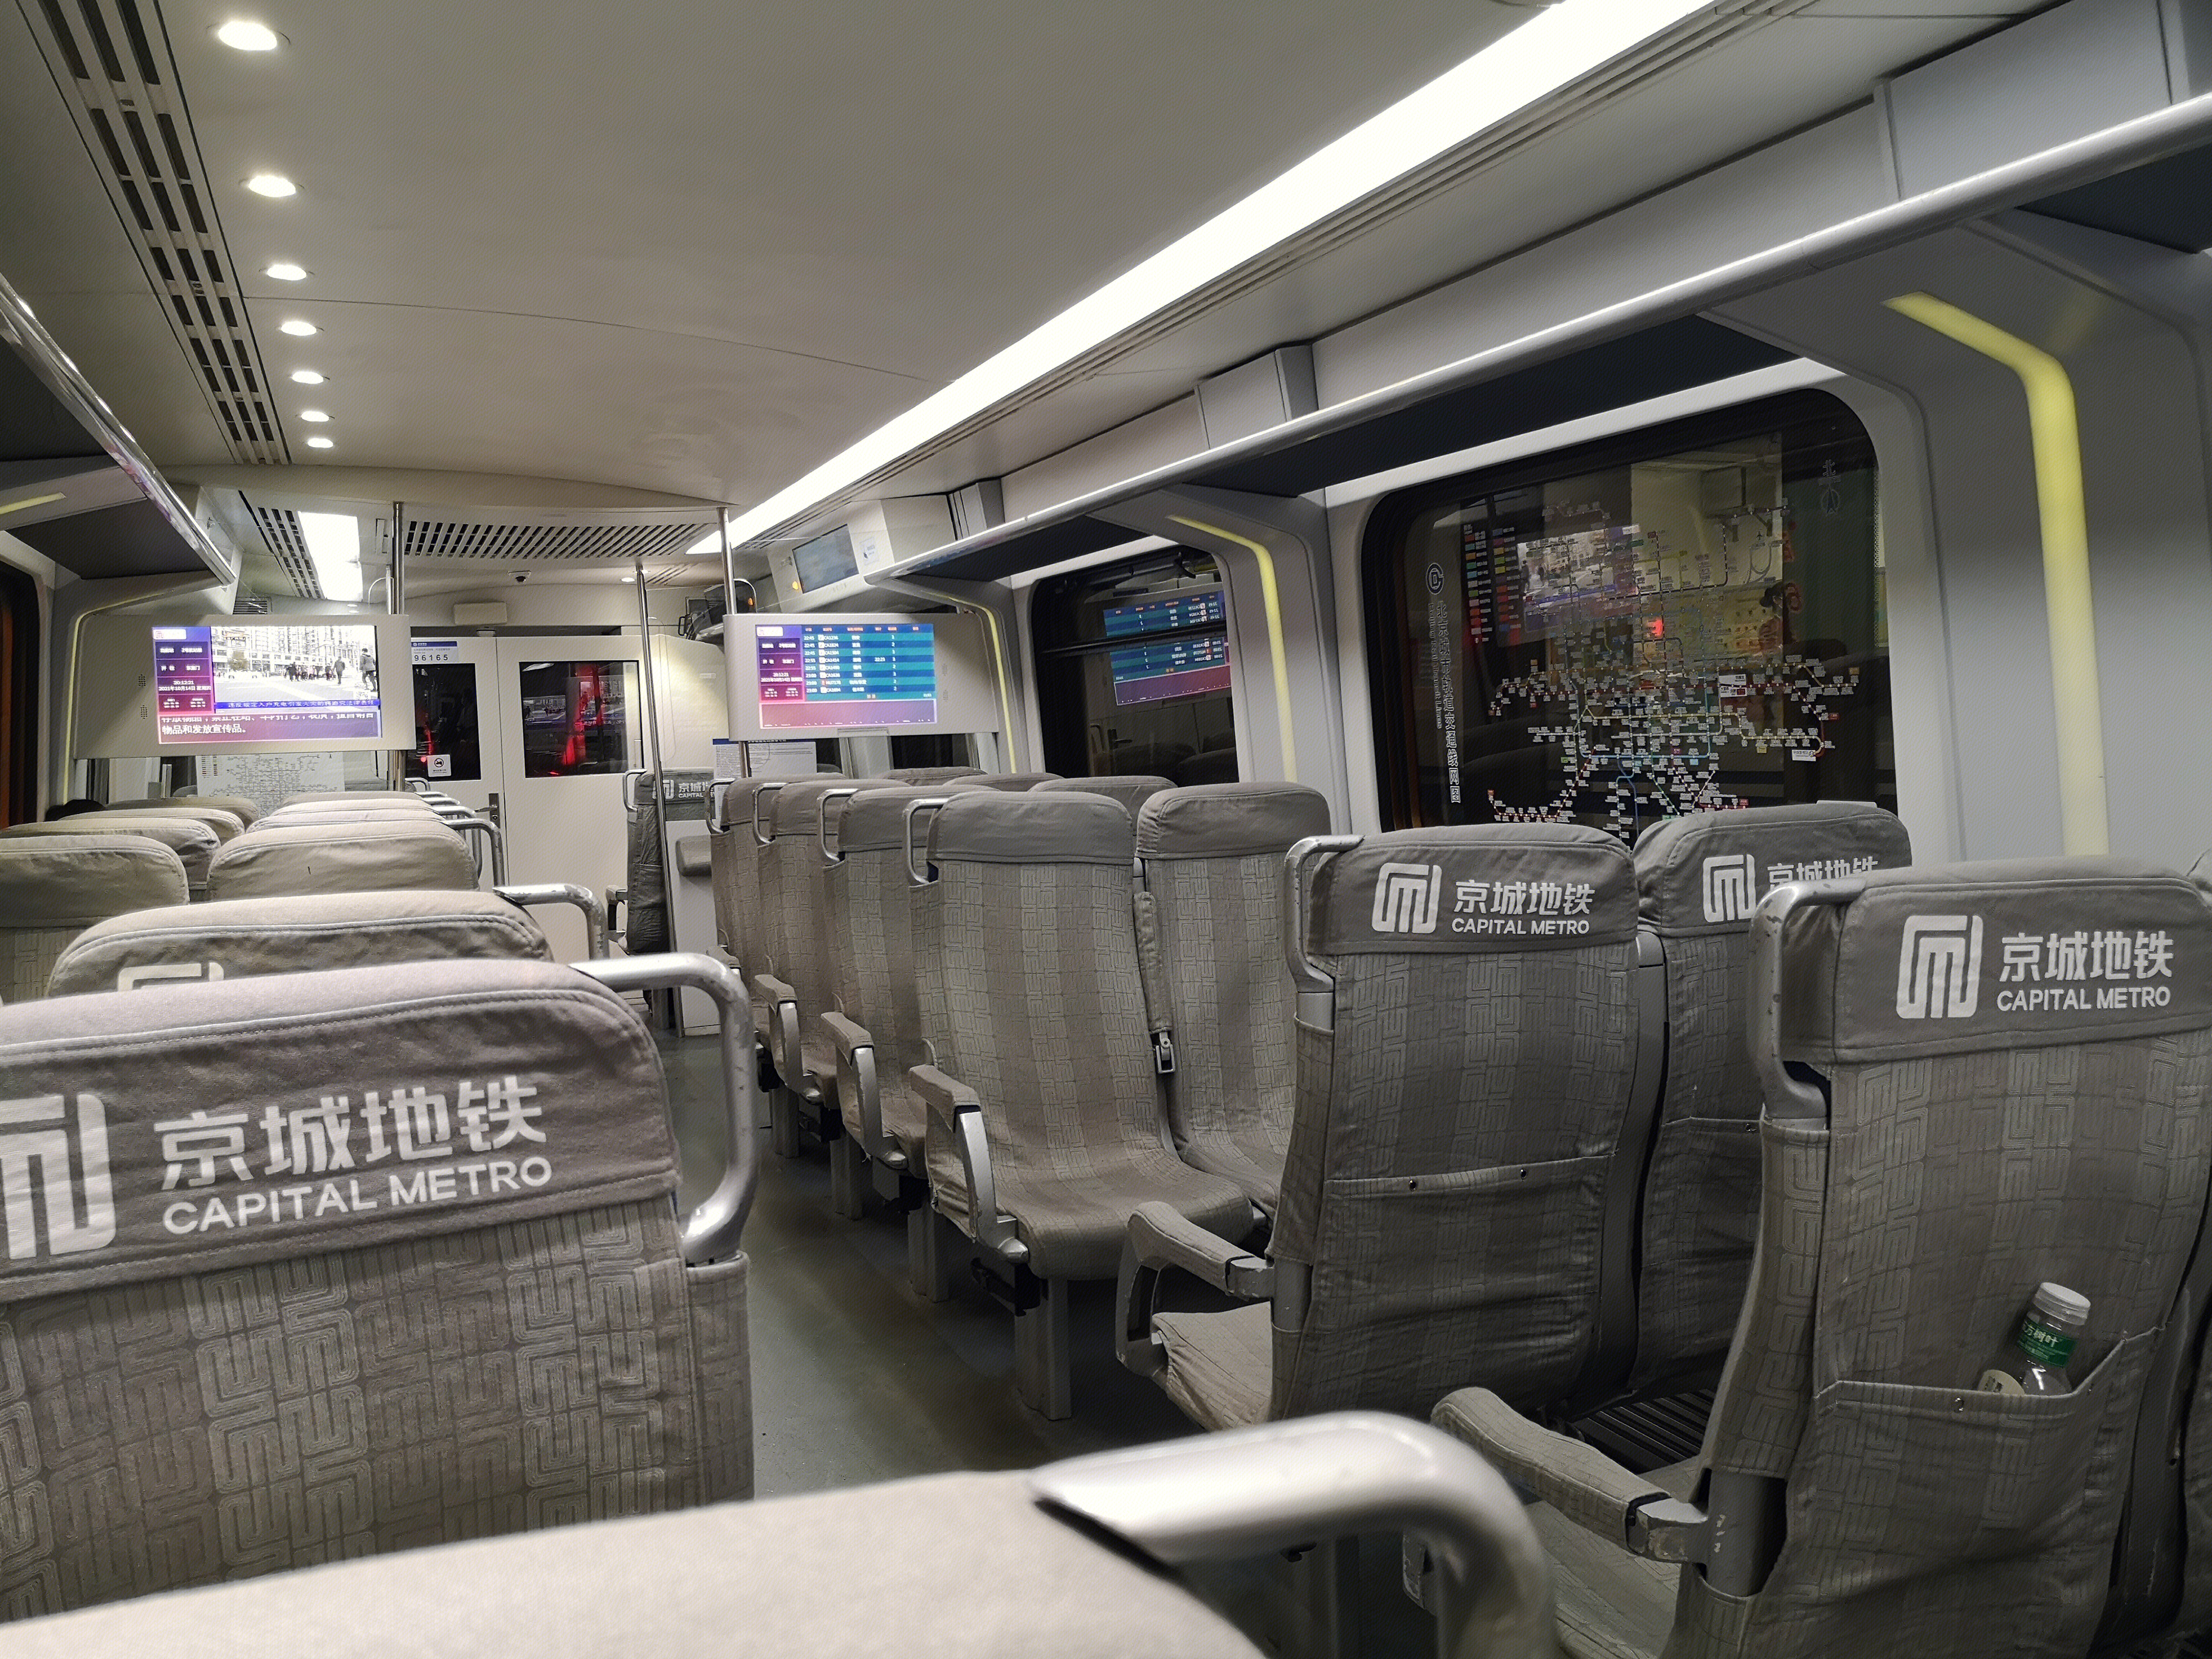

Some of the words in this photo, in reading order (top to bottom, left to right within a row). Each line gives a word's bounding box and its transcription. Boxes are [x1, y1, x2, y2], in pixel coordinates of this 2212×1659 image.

[1453, 879, 1596, 915] 京城地铁
[1452, 918, 1526, 934] CAPITAL
[1531, 920, 1590, 935] METRO
[1999, 931, 2174, 982] 京城地铁
[1996, 988, 2092, 1011] CAPITAL
[2096, 986, 2171, 1008] METRO
[153, 1075, 547, 1190] 京城地铁
[162, 1177, 378, 1234] CAPITAL
[386, 1156, 552, 1207] METRO
